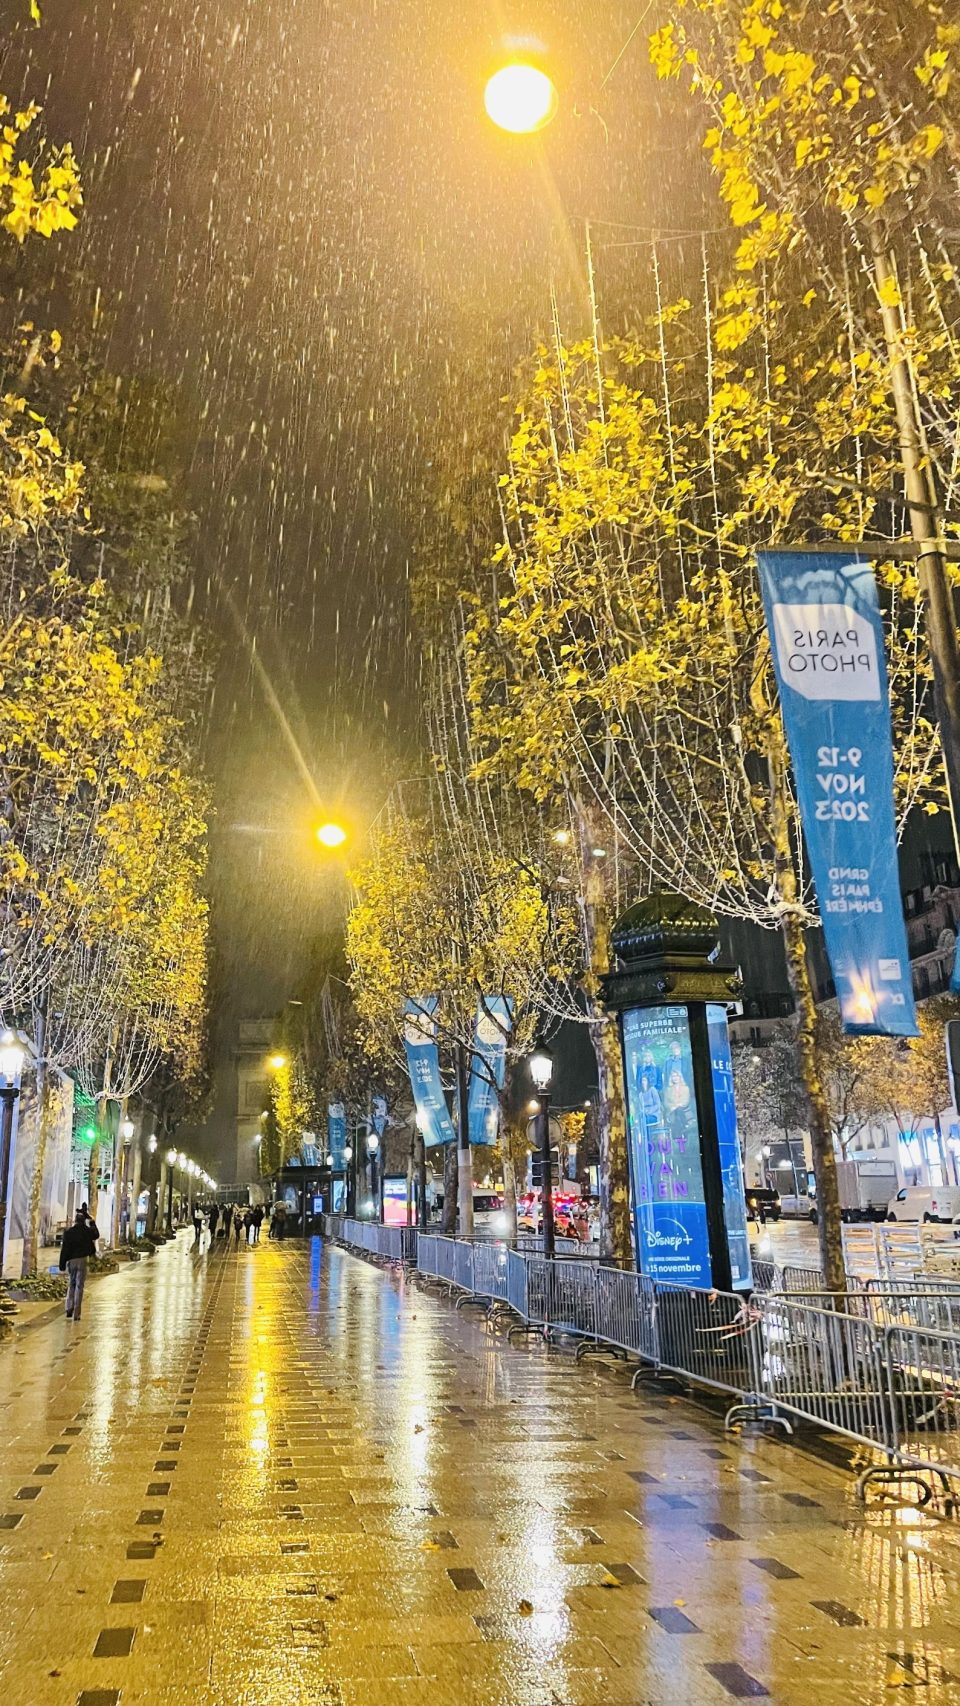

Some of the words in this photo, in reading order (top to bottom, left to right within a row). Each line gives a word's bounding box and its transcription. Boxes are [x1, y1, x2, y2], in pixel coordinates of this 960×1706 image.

[713, 1059, 724, 1069] LE
[650, 1264, 658, 1272] 15
[658, 1263, 702, 1272] novembre
